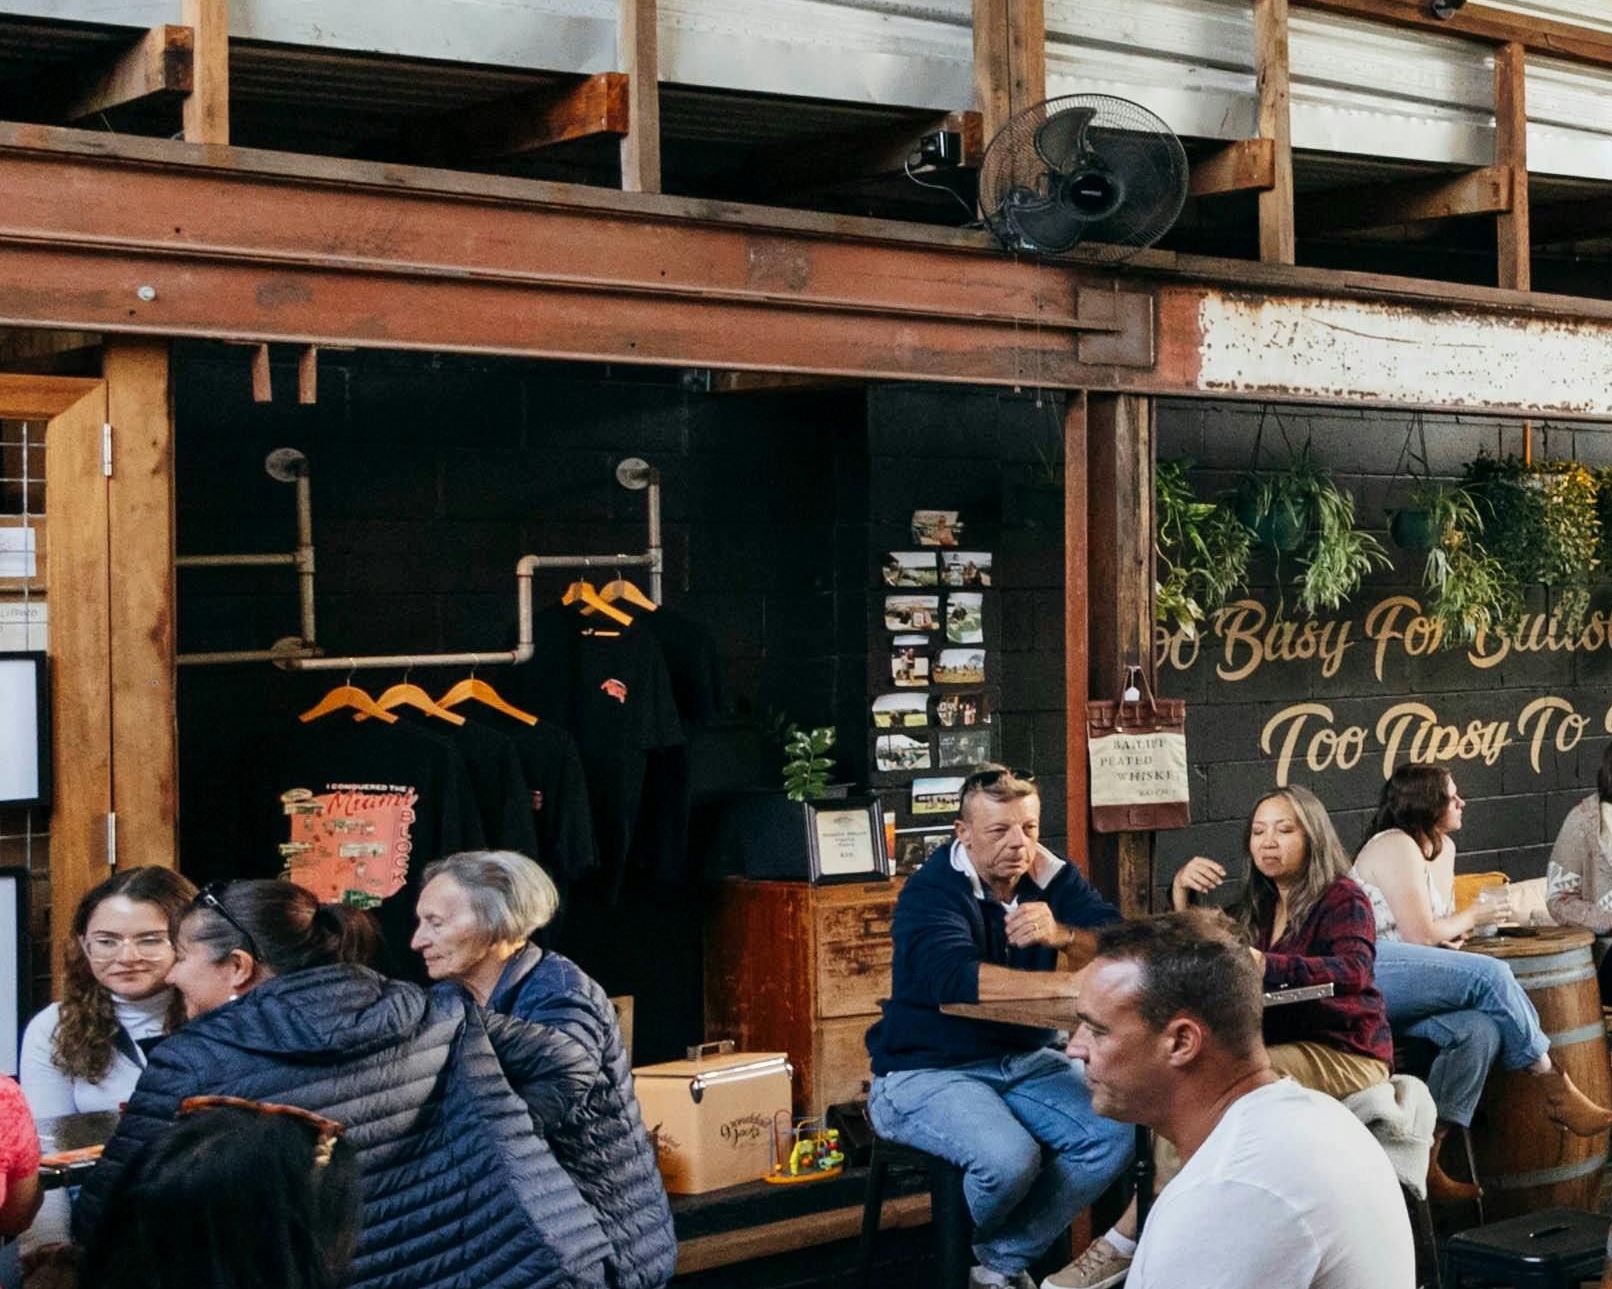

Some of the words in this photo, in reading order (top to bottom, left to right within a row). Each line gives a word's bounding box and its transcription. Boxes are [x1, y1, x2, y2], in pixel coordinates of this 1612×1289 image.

[1214, 599, 1354, 682] Busy
[1365, 596, 1446, 683] For
[1260, 702, 1368, 788] Too
[1375, 702, 1512, 782] Tipsy
[1517, 696, 1591, 774] To
